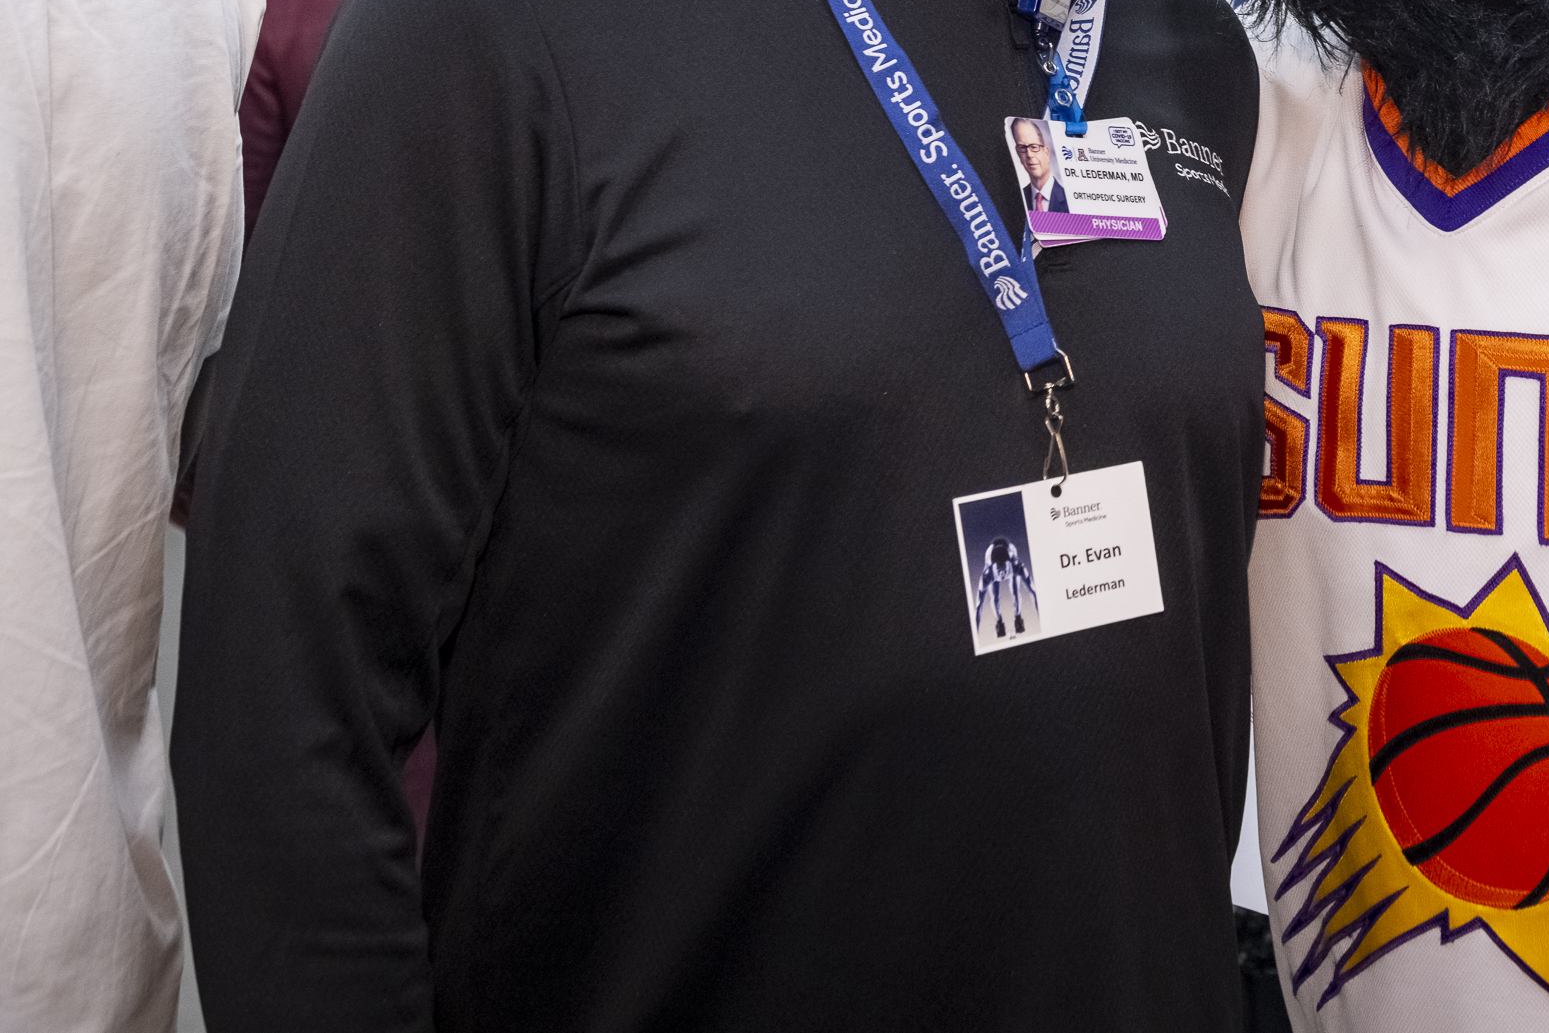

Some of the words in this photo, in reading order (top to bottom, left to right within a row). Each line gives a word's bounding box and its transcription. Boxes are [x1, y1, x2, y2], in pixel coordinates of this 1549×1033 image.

[1066, 17, 1094, 93] Banne
[886, 71, 948, 164] Sports
[1090, 156, 1114, 165] University
[1064, 168, 1079, 177] DR.
[1080, 169, 1130, 182] LEDERMAN,
[1131, 172, 1144, 182] MD
[1073, 192, 1116, 202] ORTHOPEDIC
[1116, 195, 1146, 203] SURGERY
[1092, 218, 1143, 231] PHYSICIAN
[1063, 502, 1101, 518] Banner
[1060, 553, 1081, 569] Dr.
[1085, 545, 1122, 563] Evan
[1065, 578, 1125, 600] Lederman
